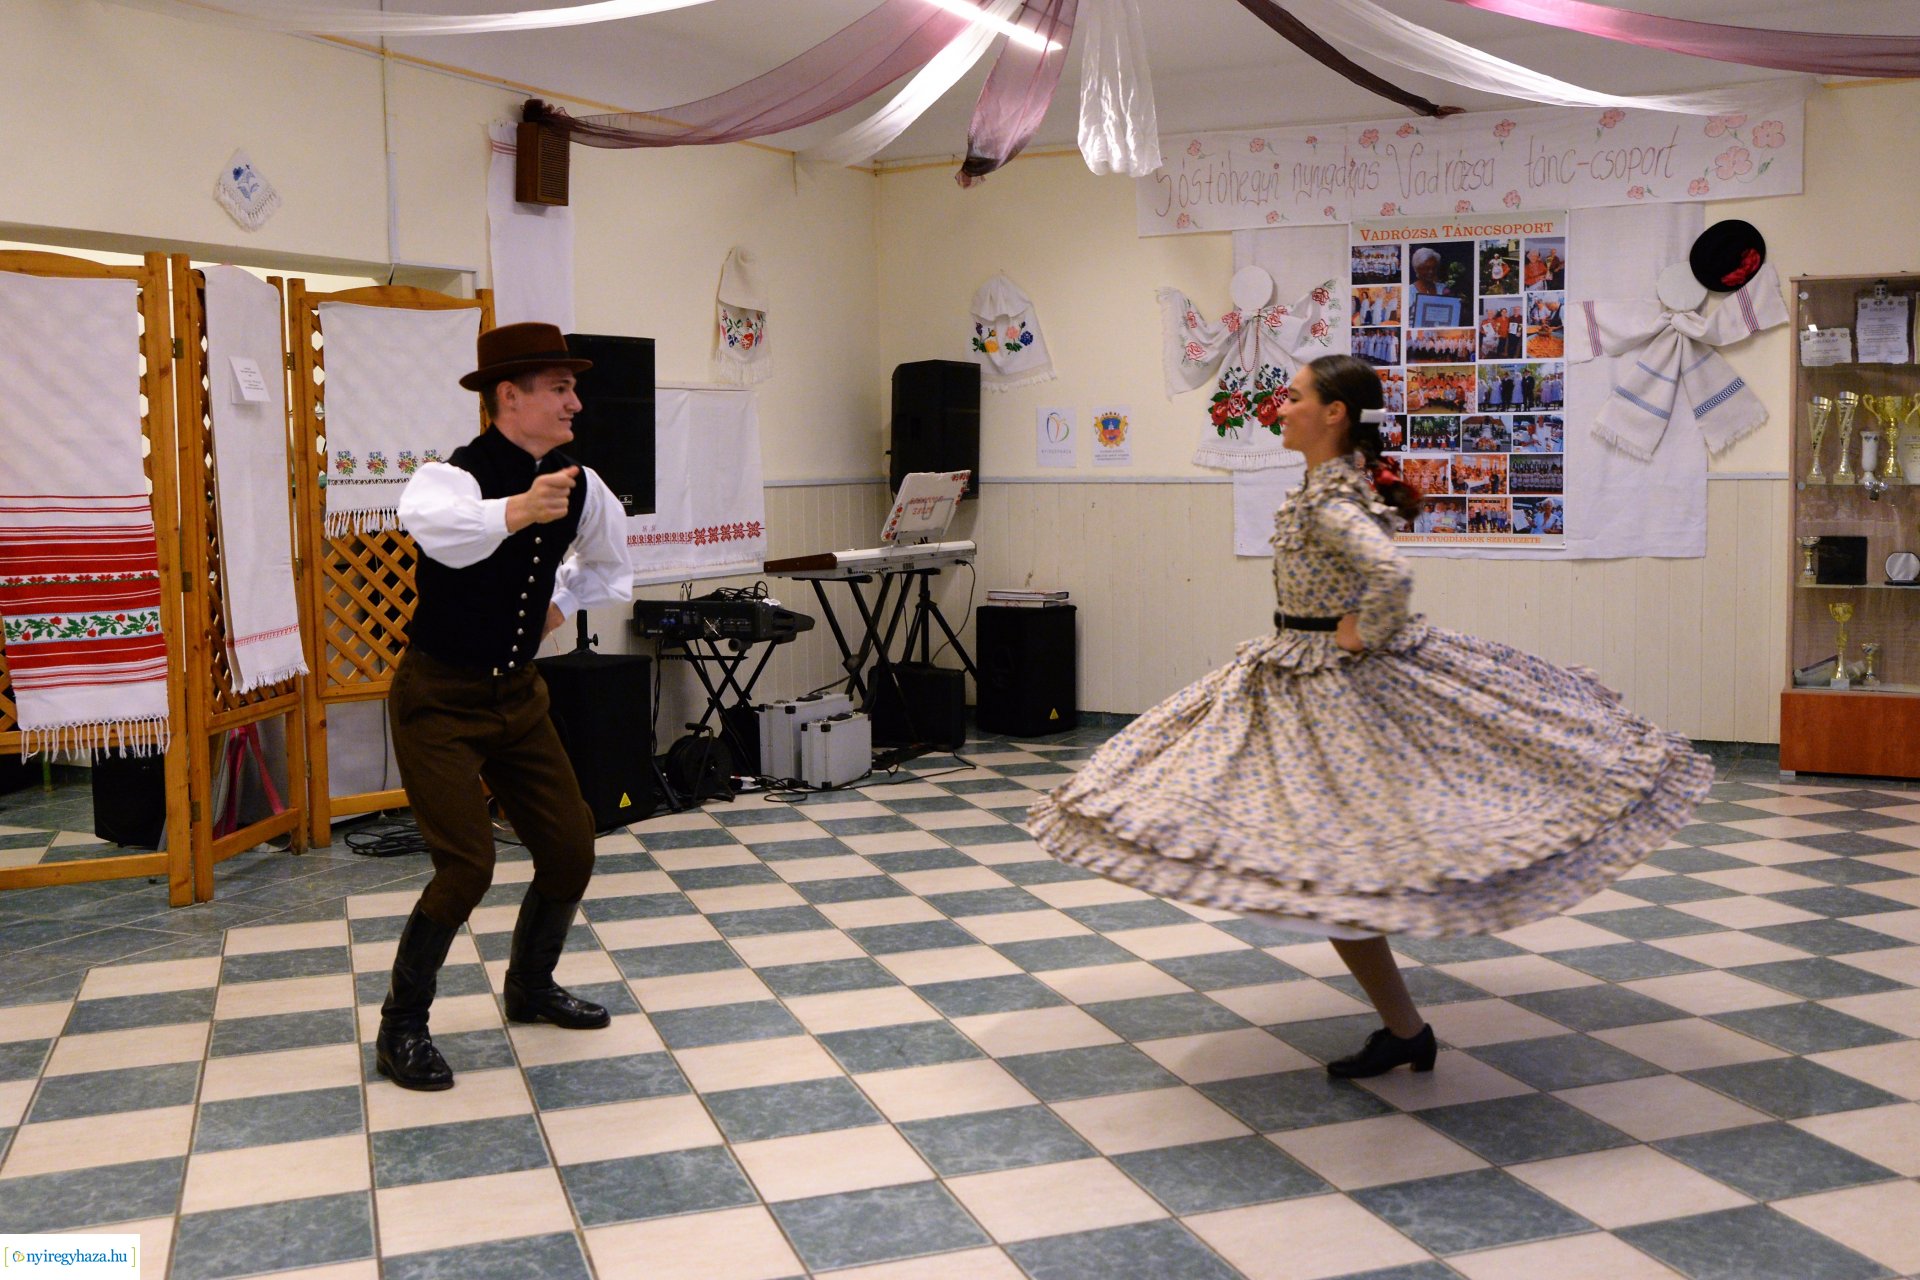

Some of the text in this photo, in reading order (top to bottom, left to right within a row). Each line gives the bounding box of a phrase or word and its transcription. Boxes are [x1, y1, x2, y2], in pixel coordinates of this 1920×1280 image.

[1385, 142, 1496, 200] Vadrózsa
[1360, 222, 1554, 242] VADRÓZSA TÁNCCSOPORT
